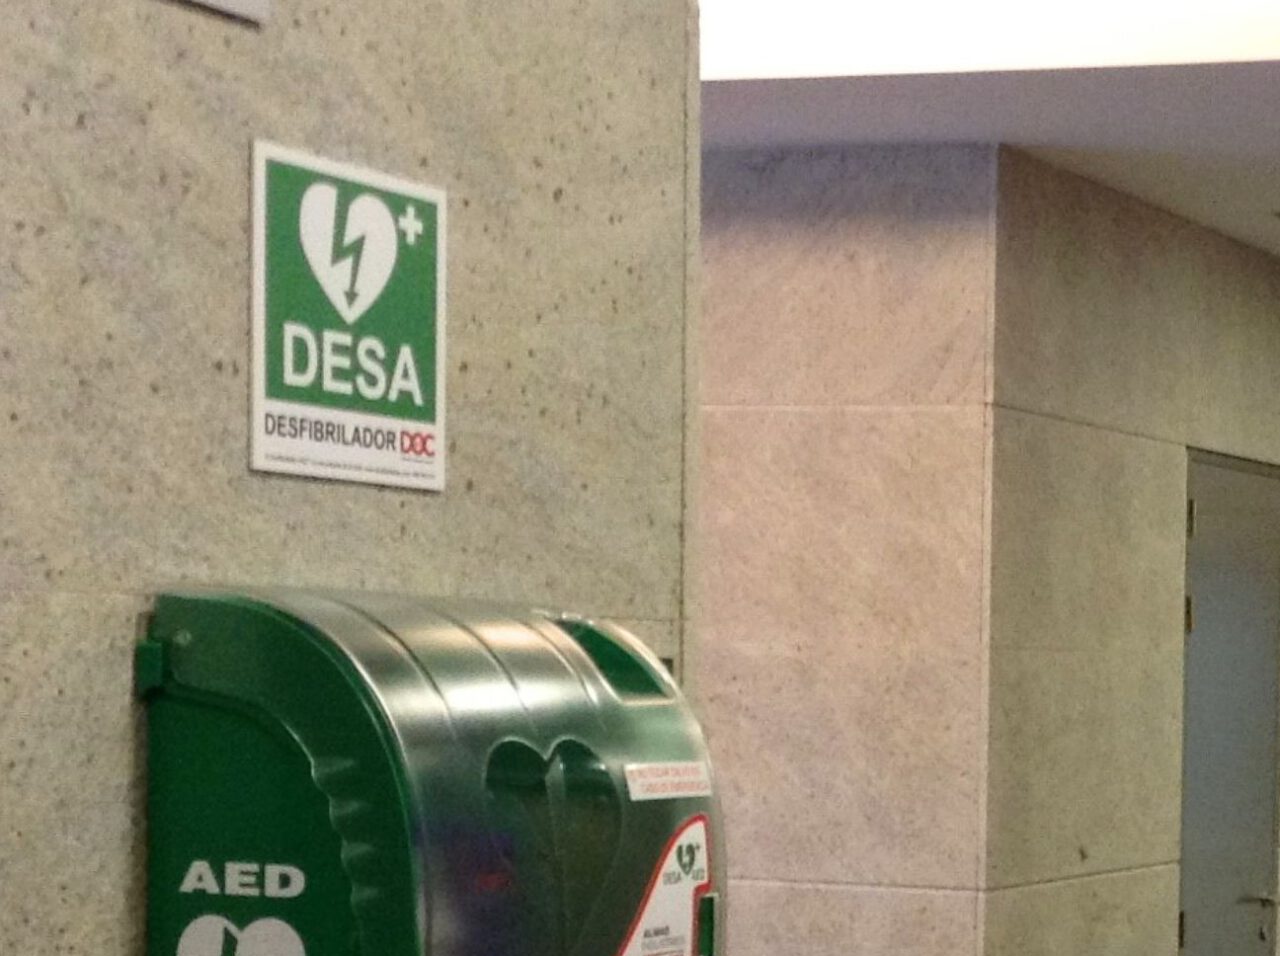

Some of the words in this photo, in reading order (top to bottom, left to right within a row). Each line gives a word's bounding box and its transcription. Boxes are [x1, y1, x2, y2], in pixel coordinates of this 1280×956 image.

[283, 321, 424, 407] DESA
[265, 413, 396, 451] DESFIBRILADOR
[400, 431, 436, 457] DOC
[179, 860, 306, 899] AED
